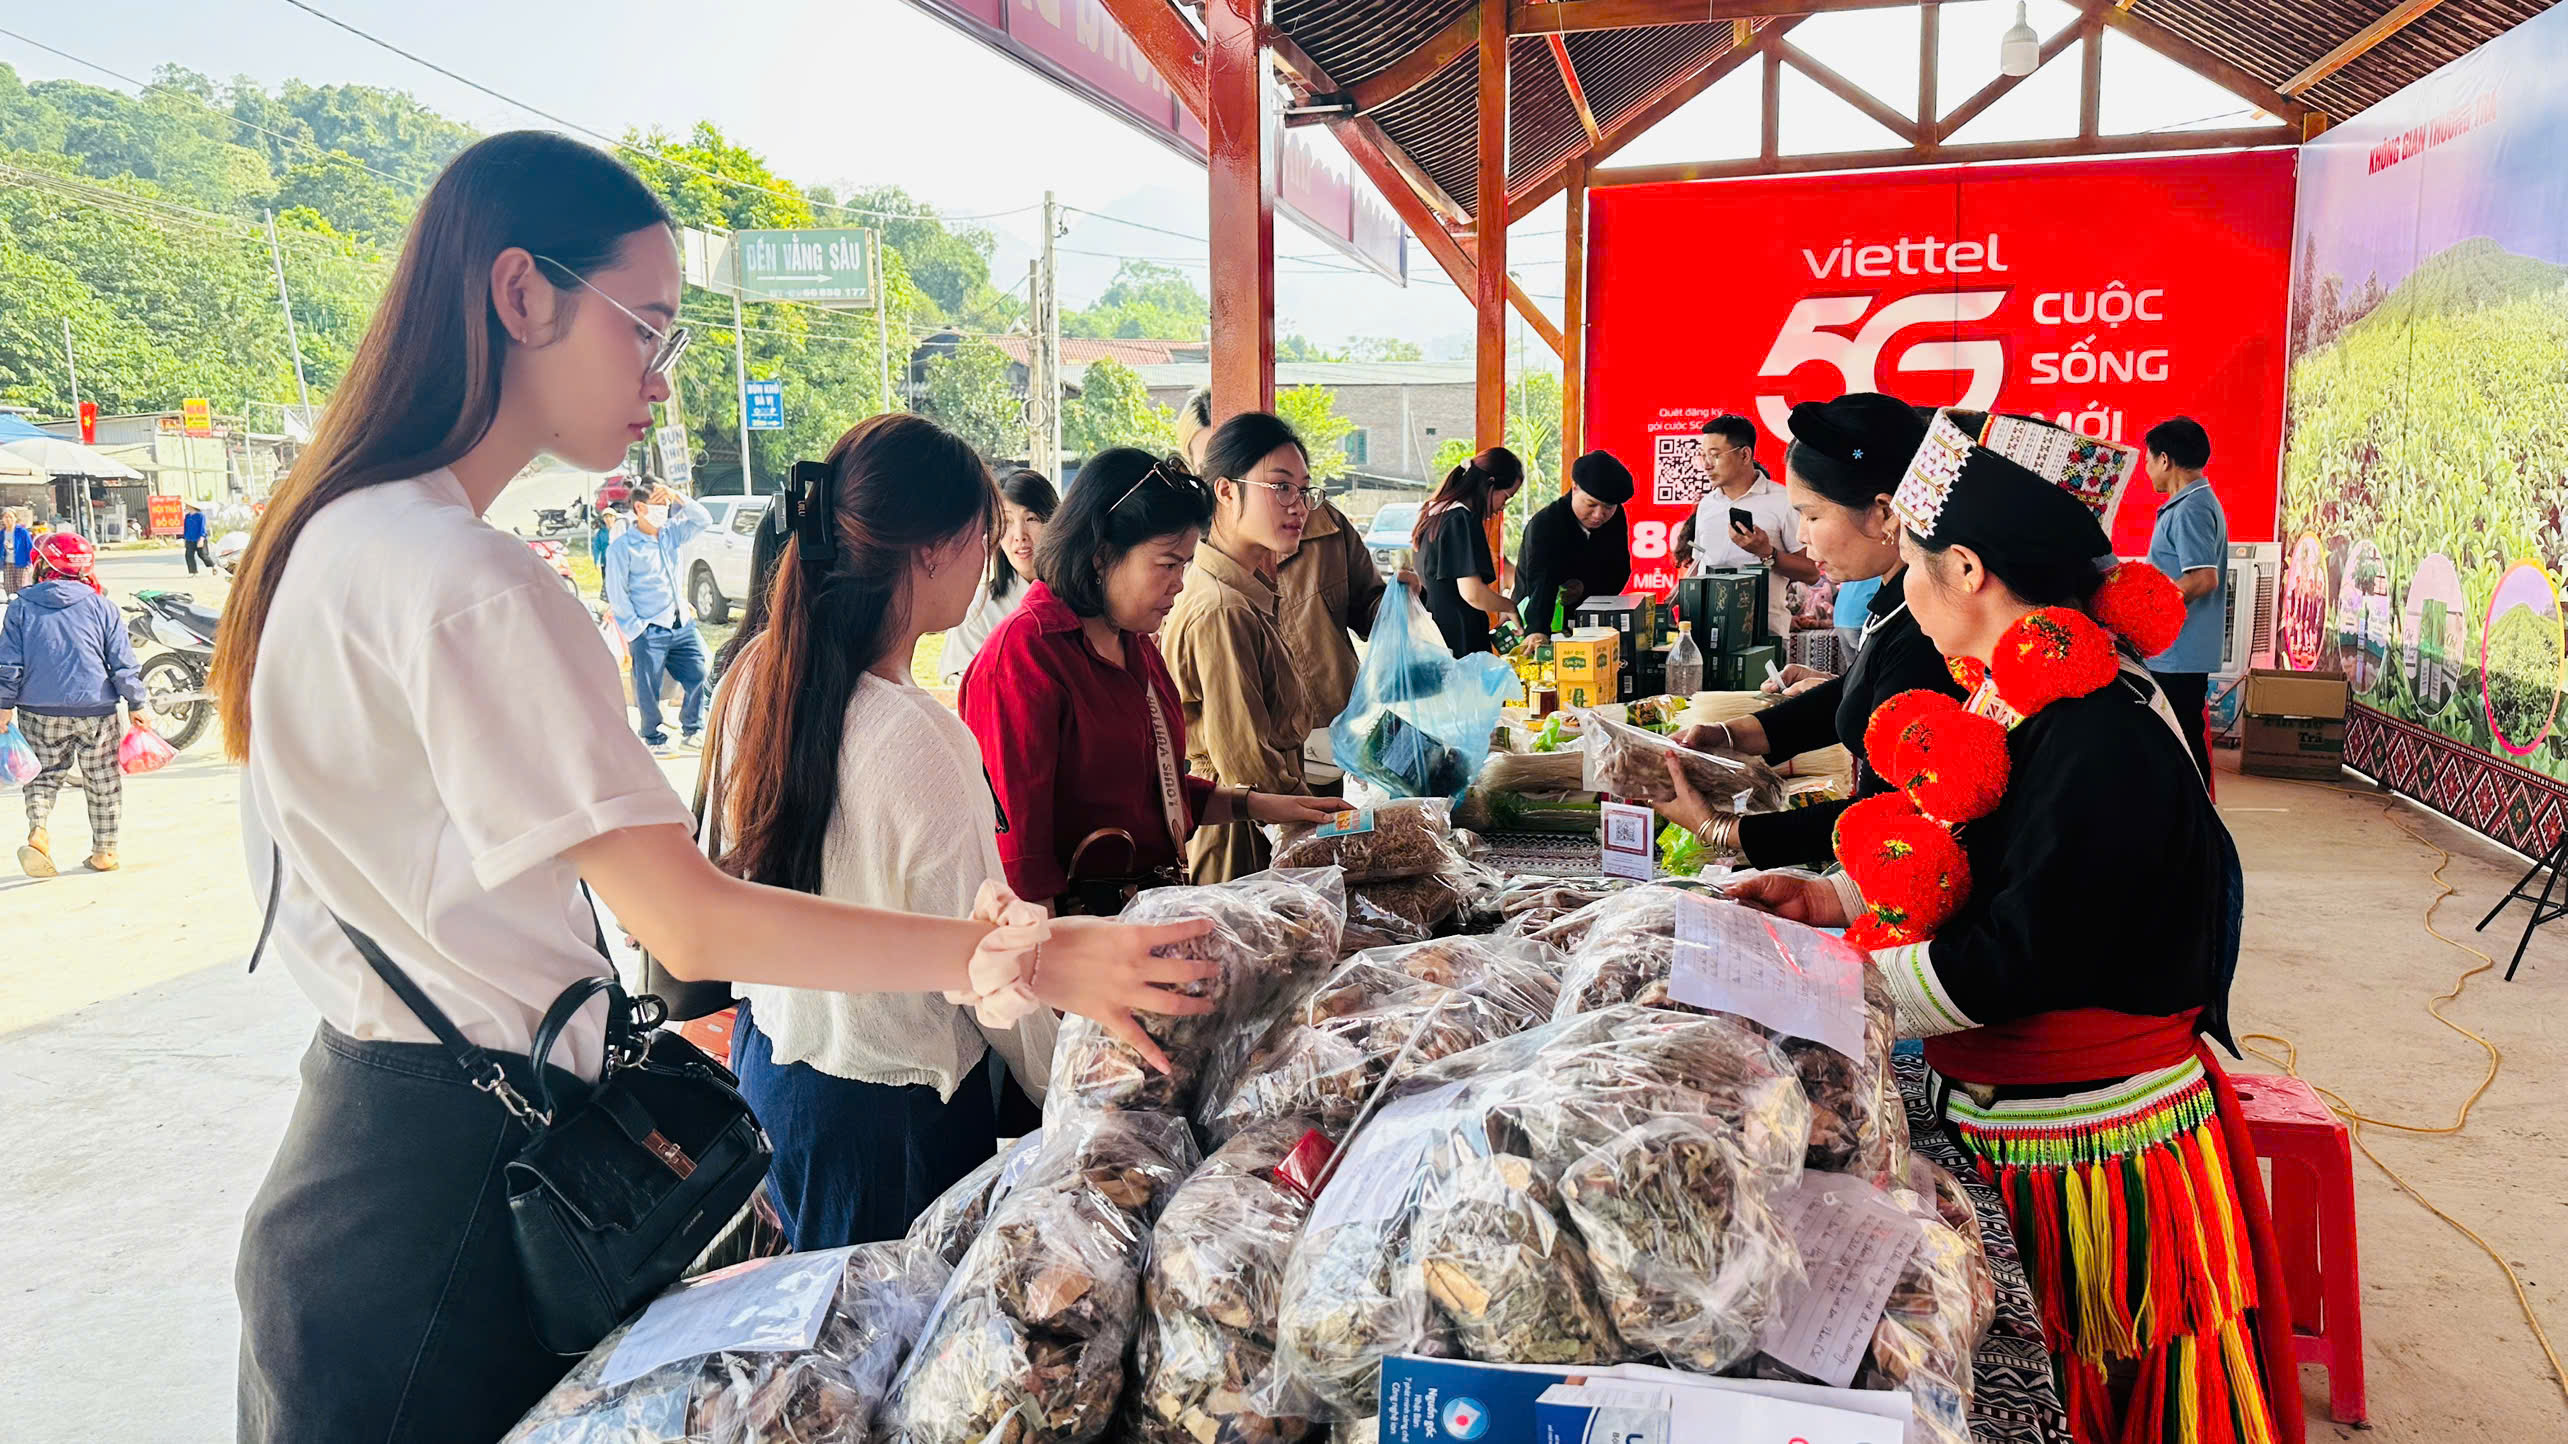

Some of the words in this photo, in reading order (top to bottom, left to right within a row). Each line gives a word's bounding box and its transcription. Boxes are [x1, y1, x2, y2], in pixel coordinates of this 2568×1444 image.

[2369, 136, 2400, 176] KHÔNG
[2402, 122, 2426, 160] GIAN
[829, 235, 862, 272] SÂU
[1803, 234, 2008, 279] viettel
[2033, 280, 2164, 329] CUỘC
[1756, 290, 2008, 442] 5G
[2031, 334, 2169, 384] SỐNG
[1685, 407, 1710, 418] đăng
[2030, 400, 2122, 442] ỚI
[1162, 762, 1178, 806] LOUIS
